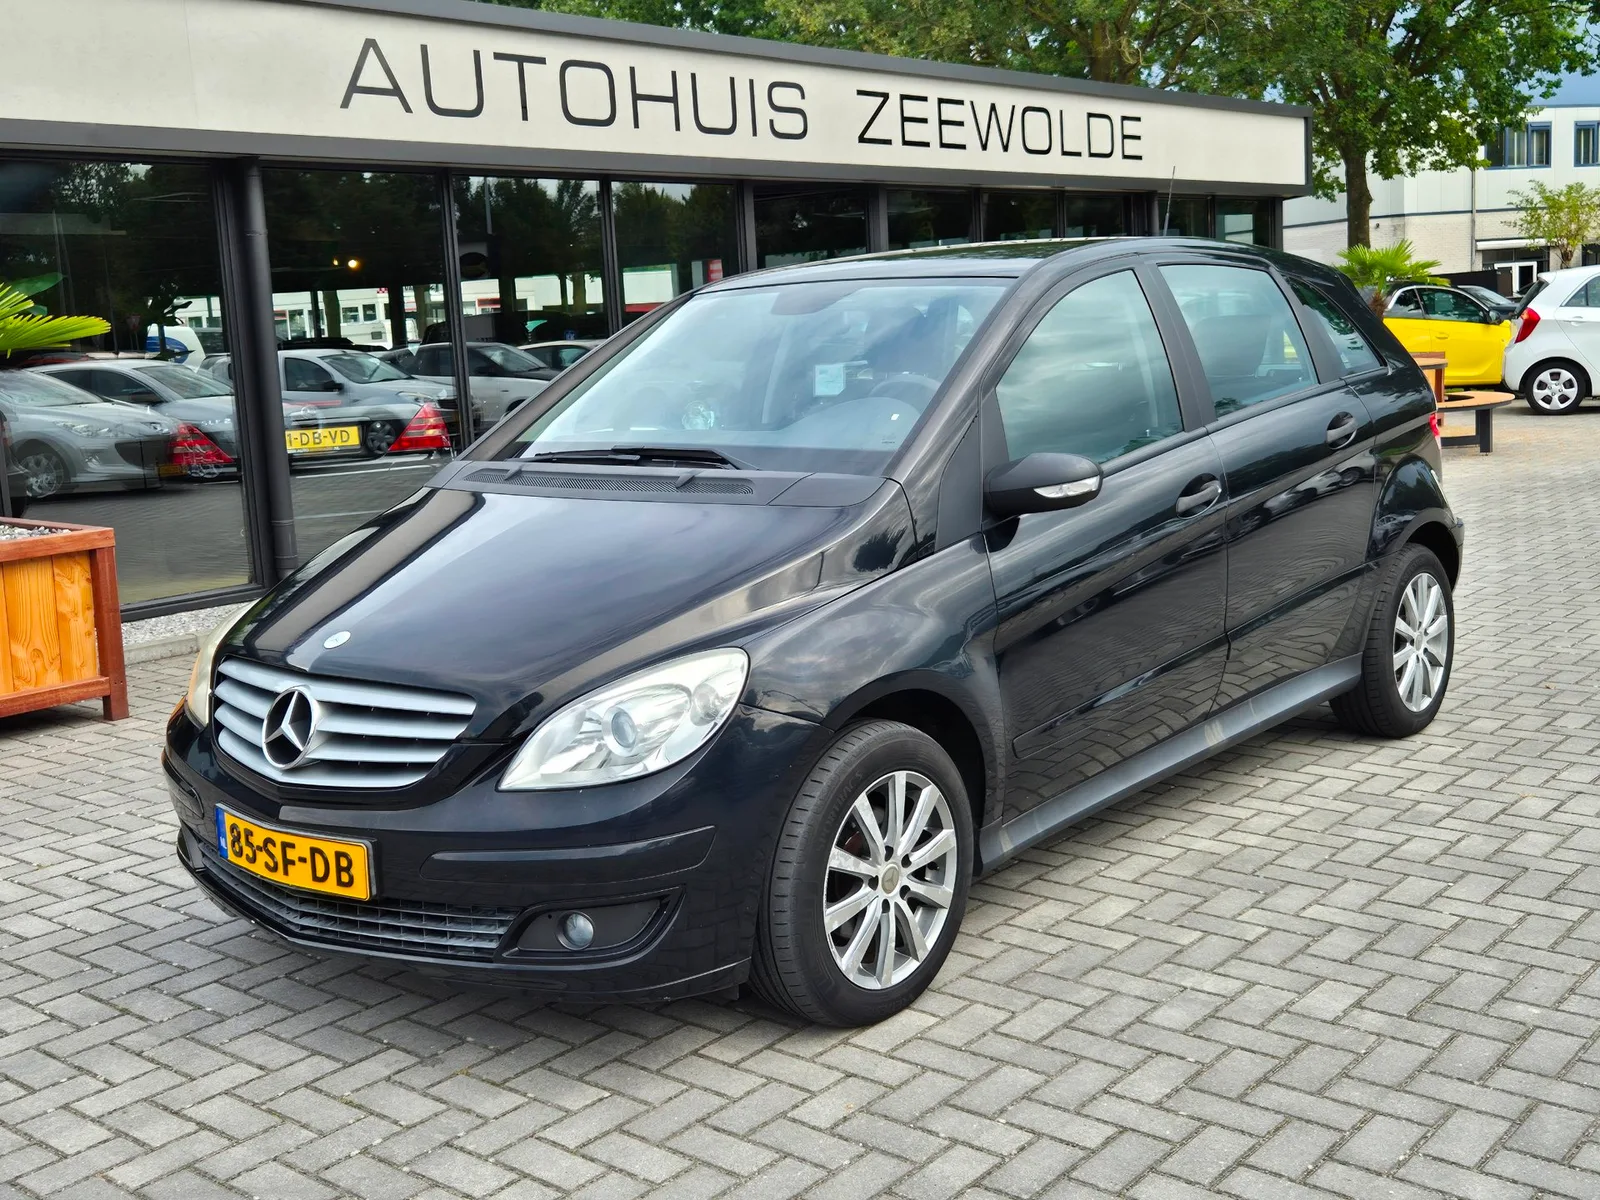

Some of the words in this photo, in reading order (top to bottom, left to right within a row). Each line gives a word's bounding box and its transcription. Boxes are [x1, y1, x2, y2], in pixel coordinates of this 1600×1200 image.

[340, 37, 809, 140] AUTOHUIS
[856, 89, 1143, 161] ZEEWOLDE
[229, 822, 355, 888] 85-SF-DB
